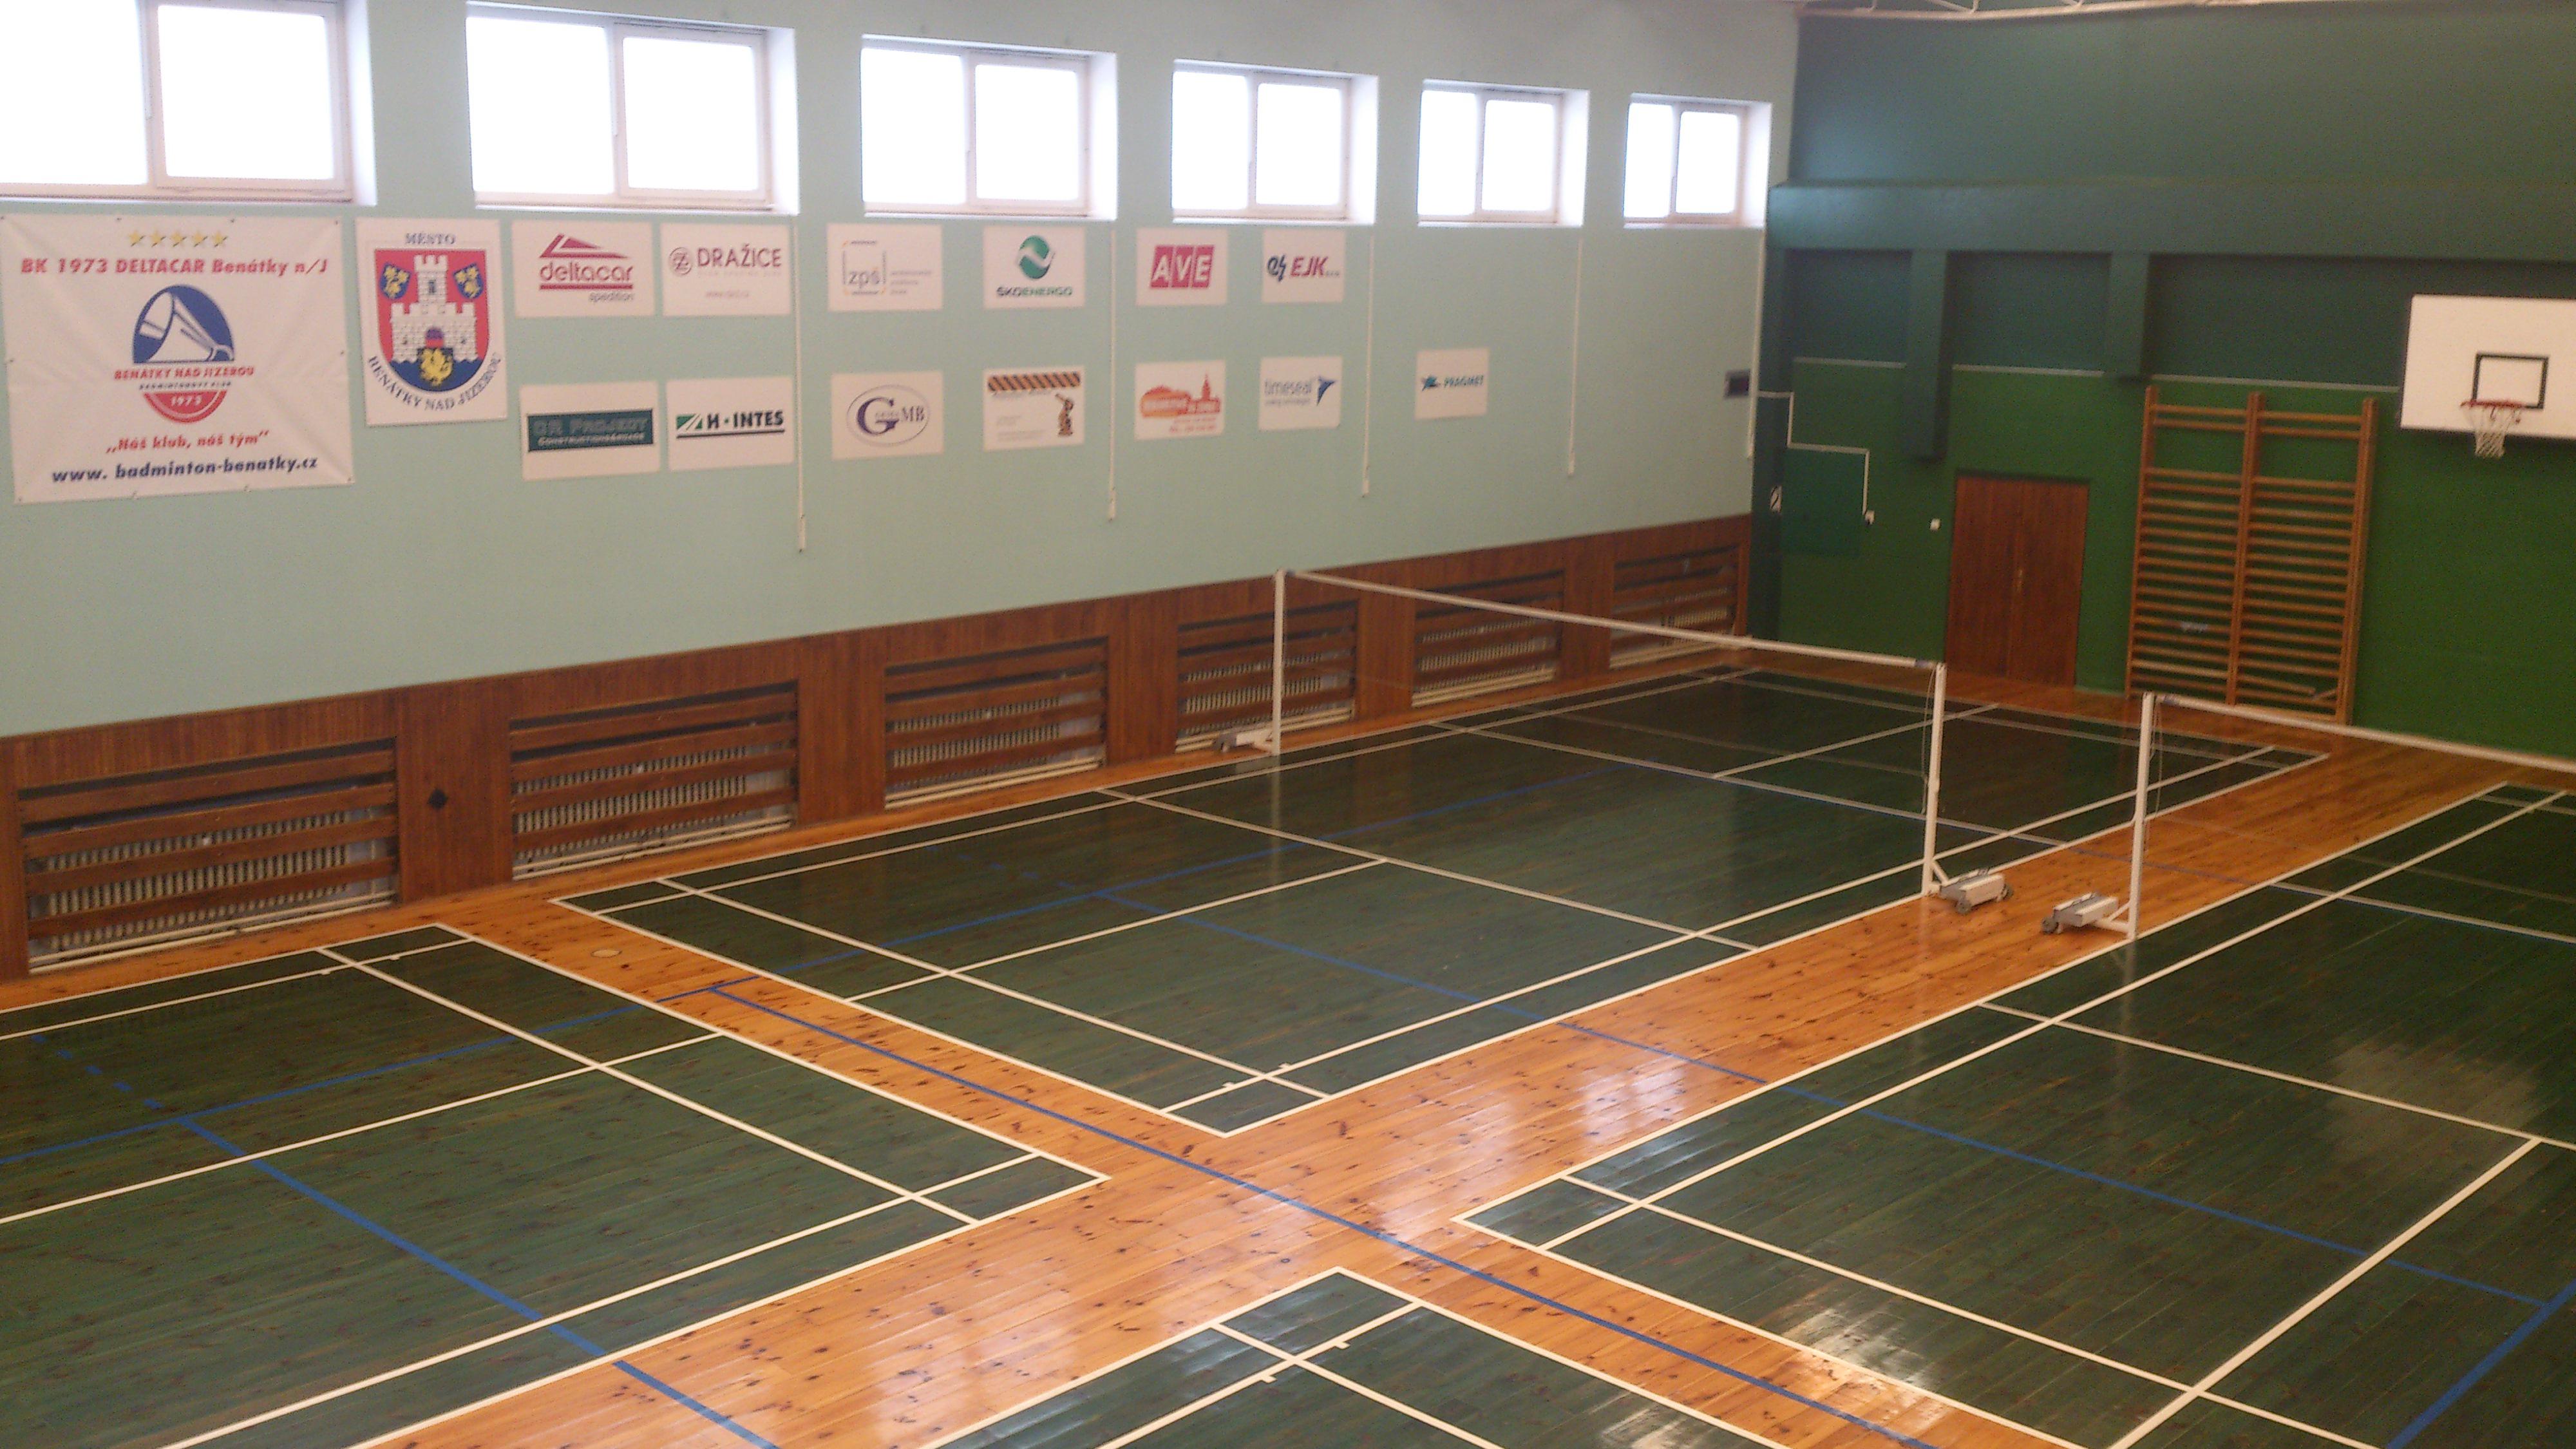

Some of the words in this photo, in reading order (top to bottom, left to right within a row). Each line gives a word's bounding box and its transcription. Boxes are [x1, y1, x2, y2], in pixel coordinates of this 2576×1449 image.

[697, 243, 782, 267] DRAŽICE
[21, 258, 47, 274] BK
[59, 258, 108, 274] 1973
[115, 258, 205, 274] DELTACAR
[211, 258, 288, 278] Benátky
[540, 261, 634, 281] deltacar
[1152, 254, 1212, 282] AVE
[171, 395, 203, 406] 1973
[52, 469, 108, 482] www.
[115, 453, 319, 480] badminton-benatky.cz
